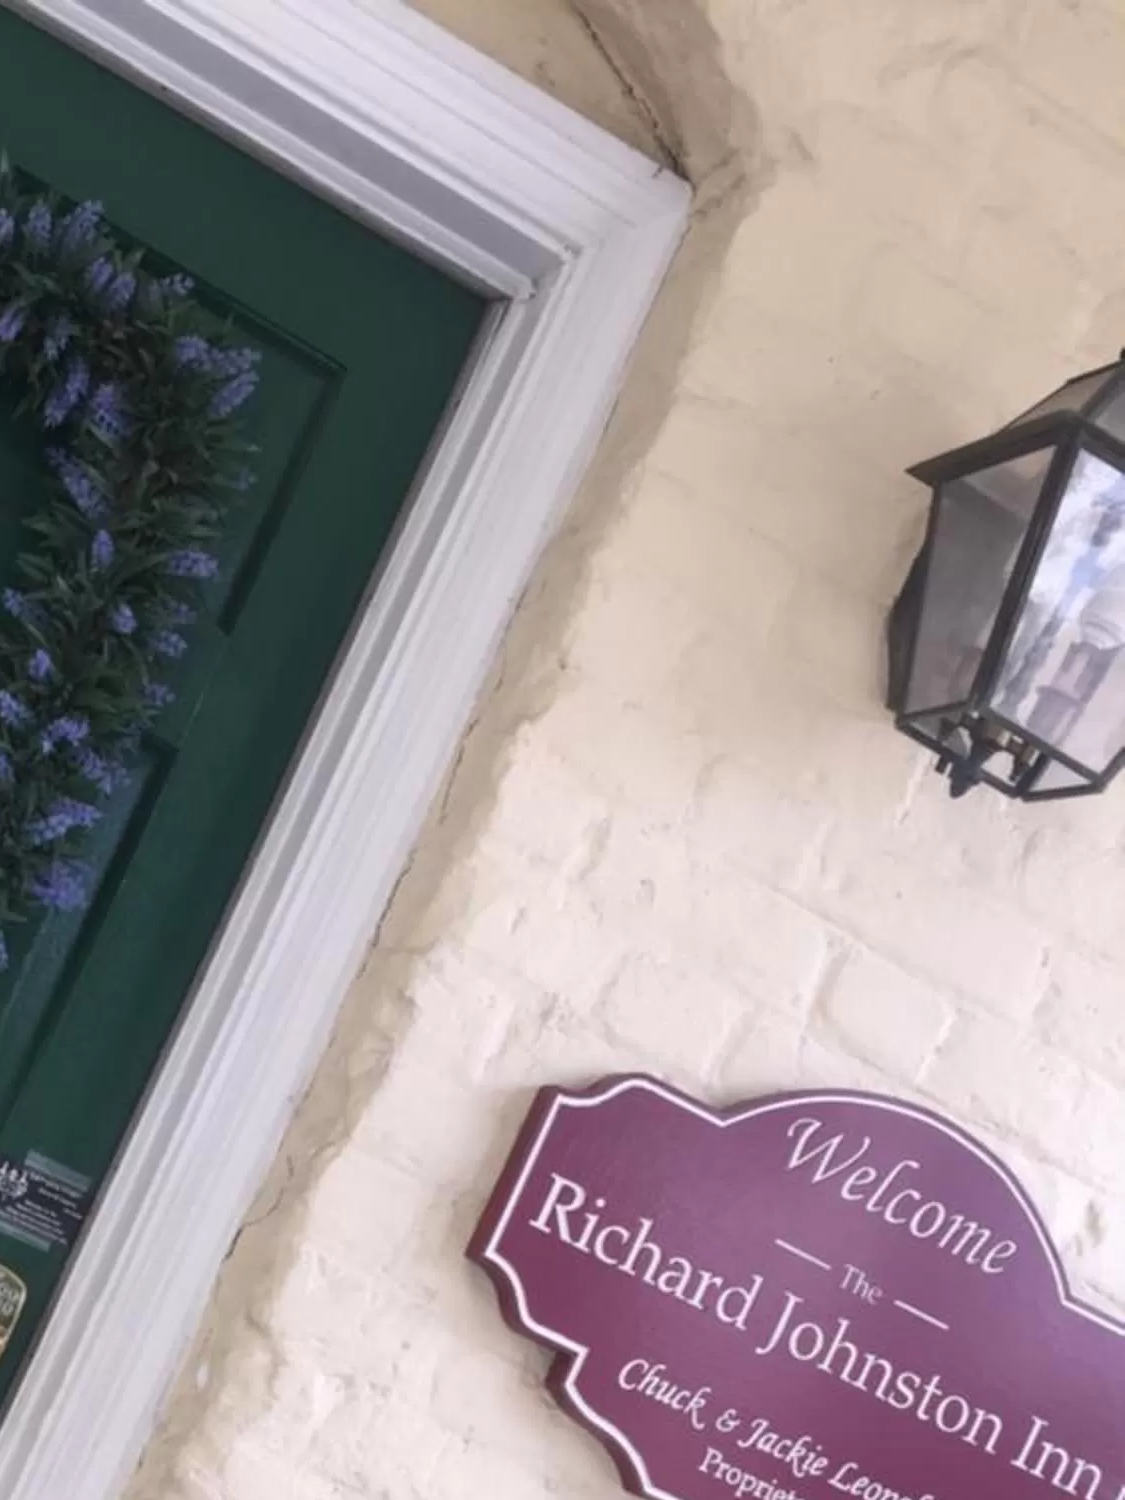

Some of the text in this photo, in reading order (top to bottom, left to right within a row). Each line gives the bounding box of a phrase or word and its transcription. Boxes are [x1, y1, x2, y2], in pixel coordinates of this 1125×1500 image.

[786, 1117, 1019, 1275] Welcome
[528, 1173, 763, 1330] Richard
[756, 1292, 1005, 1456] Johnston
[839, 1263, 884, 1304] The
[618, 1358, 711, 1430] Chuck
[715, 1408, 740, 1432] &
[737, 1419, 830, 1478] Jackie
